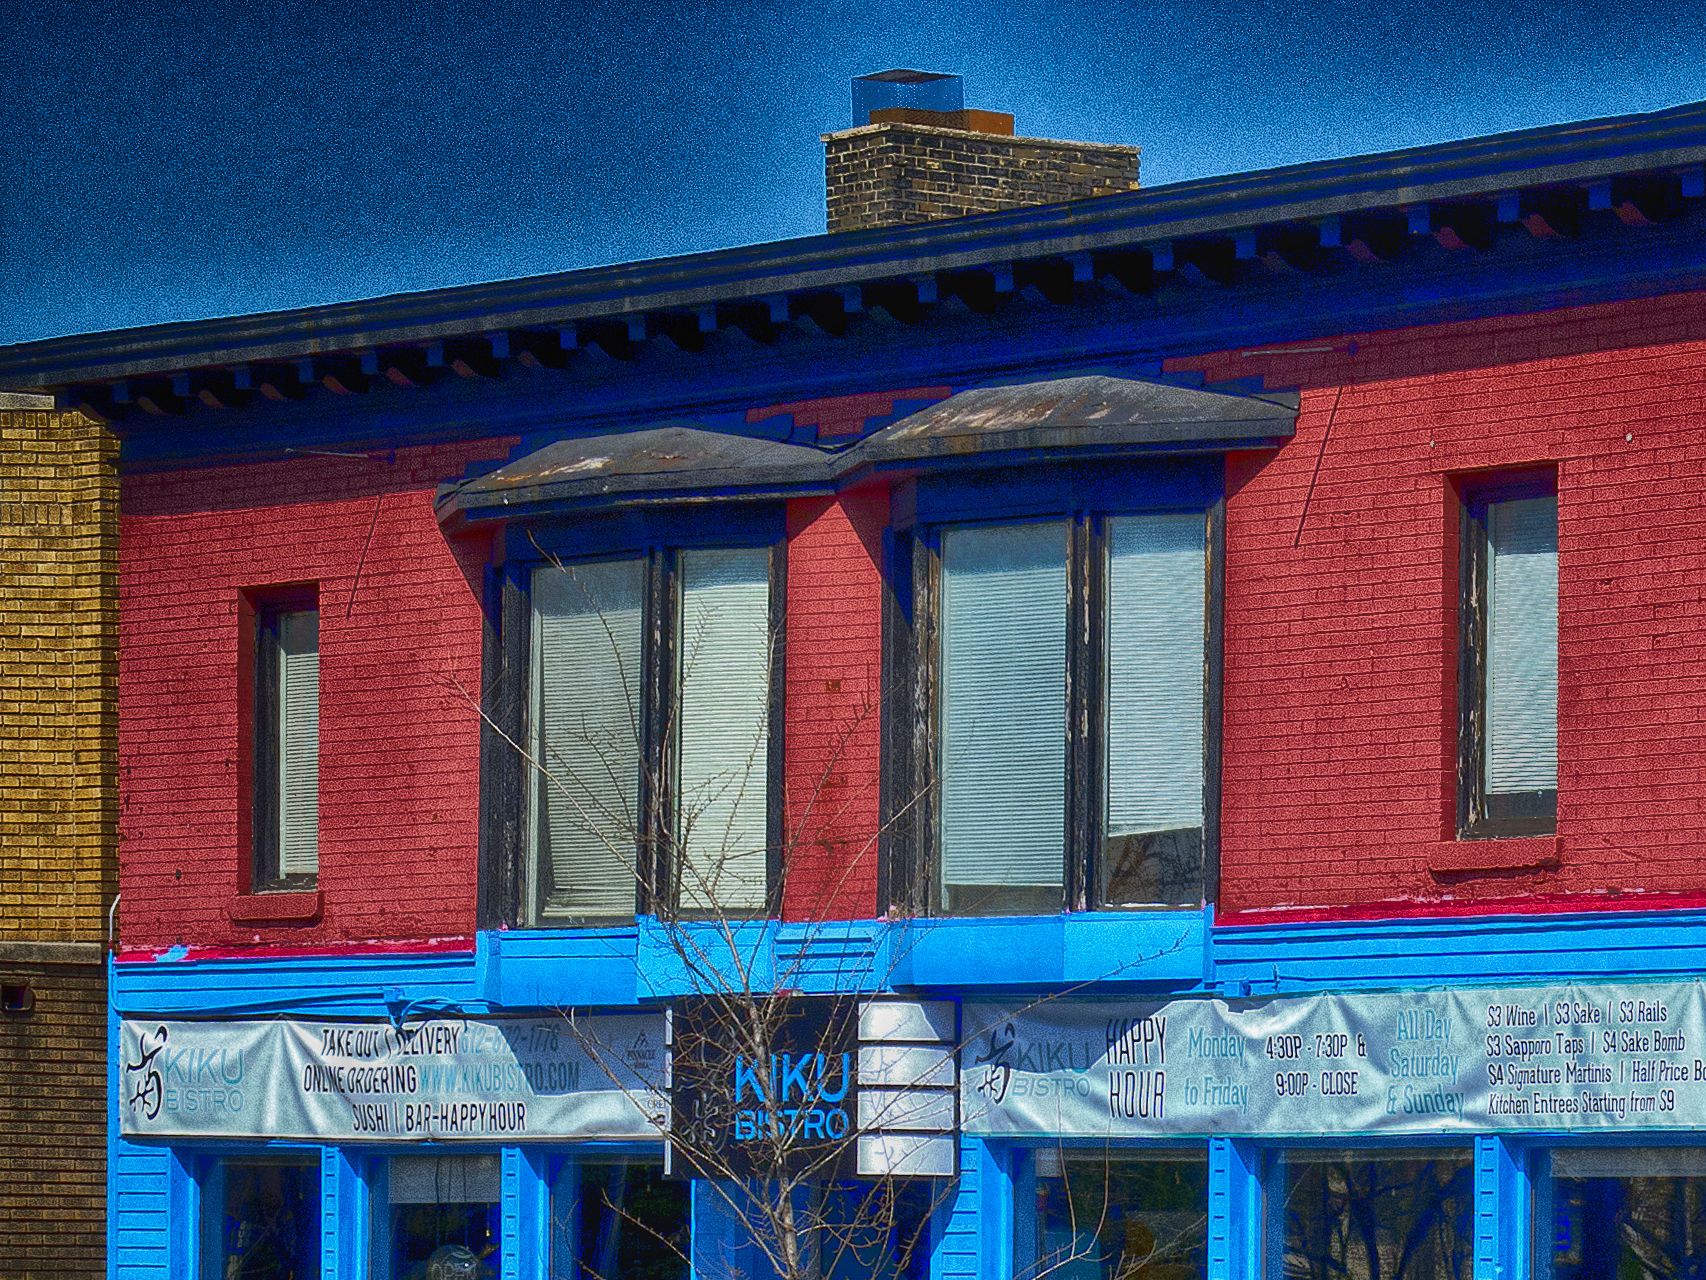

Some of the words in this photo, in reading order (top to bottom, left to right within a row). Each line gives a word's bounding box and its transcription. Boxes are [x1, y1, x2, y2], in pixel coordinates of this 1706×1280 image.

[1397, 1009, 1419, 1040] All
[1425, 1008, 1452, 1047] Day
[1506, 1005, 1536, 1026] Wine
[1573, 1002, 1601, 1024] Sake
[1637, 1000, 1667, 1022] Rails
[322, 1028, 352, 1056] TAKE
[357, 1029, 379, 1058] OUT
[1106, 1016, 1167, 1065] HAPPY
[1187, 1025, 1247, 1067] Monday
[1265, 1035, 1302, 1059] 4:30P
[1315, 1034, 1348, 1058] 7:30P
[1357, 1033, 1367, 1057] &
[1505, 1035, 1552, 1062] Sapporo
[1556, 1032, 1584, 1059] Taps
[1621, 1030, 1649, 1053] Sake
[1654, 1029, 1685, 1052] Bomb
[163, 1048, 244, 1084] KIKU
[1016, 1041, 1092, 1074] KIKU
[1389, 1048, 1460, 1084] Saturday
[303, 1064, 346, 1094] ONLINE
[349, 1063, 417, 1094] ORDERING
[735, 1053, 849, 1103] KIKU
[1012, 1076, 1091, 1098] BISTRO
[1275, 1071, 1309, 1096] 9:00P
[1320, 1071, 1359, 1096] CLOSE
[1508, 1063, 1561, 1091] Signature
[1565, 1061, 1612, 1084] Martinis
[1632, 1060, 1656, 1083] Half
[1658, 1060, 1689, 1082] Price
[165, 1090, 244, 1112] BISTRO
[1109, 1071, 1165, 1118] HOUR
[1184, 1081, 1199, 1106] to
[1203, 1075, 1249, 1114] Friday
[1386, 1085, 1396, 1115] &
[1402, 1085, 1465, 1121] Sunday
[1488, 1093, 1530, 1115] Kitchen
[1533, 1092, 1579, 1114] Entrees
[1582, 1091, 1626, 1119] Starting
[1630, 1090, 1656, 1112] from
[352, 1103, 389, 1132] SUSHI
[735, 1108, 849, 1141] BISTRO
